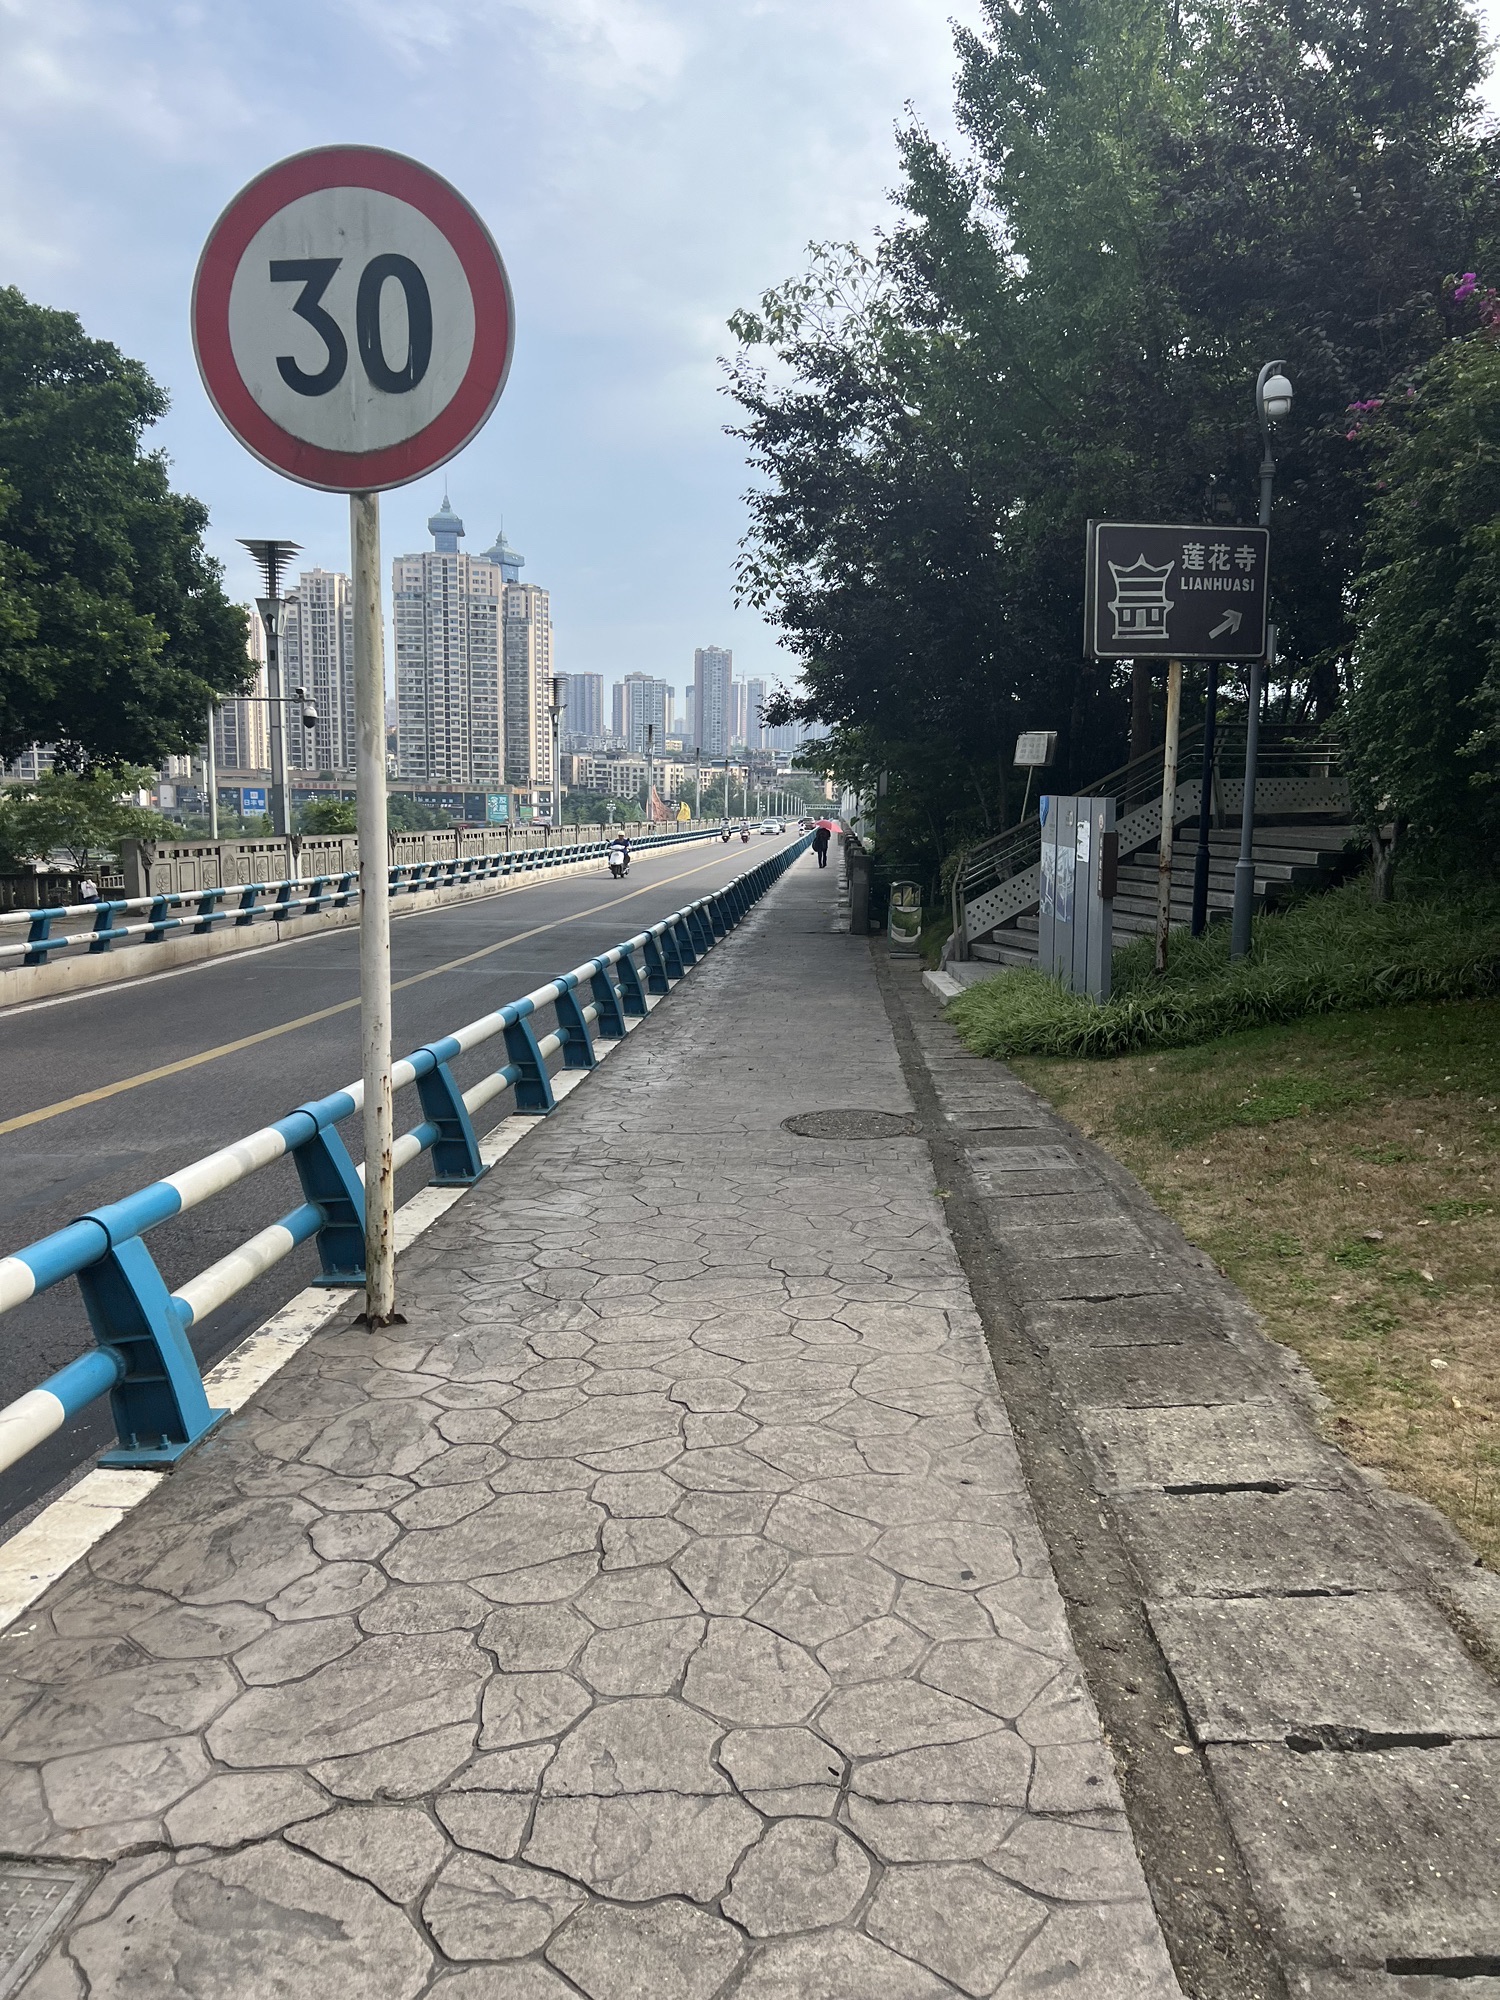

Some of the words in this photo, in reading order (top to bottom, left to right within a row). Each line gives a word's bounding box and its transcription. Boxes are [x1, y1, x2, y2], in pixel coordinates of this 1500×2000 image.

[269, 253, 433, 397] 30
[1181, 542, 1257, 572] 莲花寺
[1180, 576, 1255, 592] LIANHUASI
